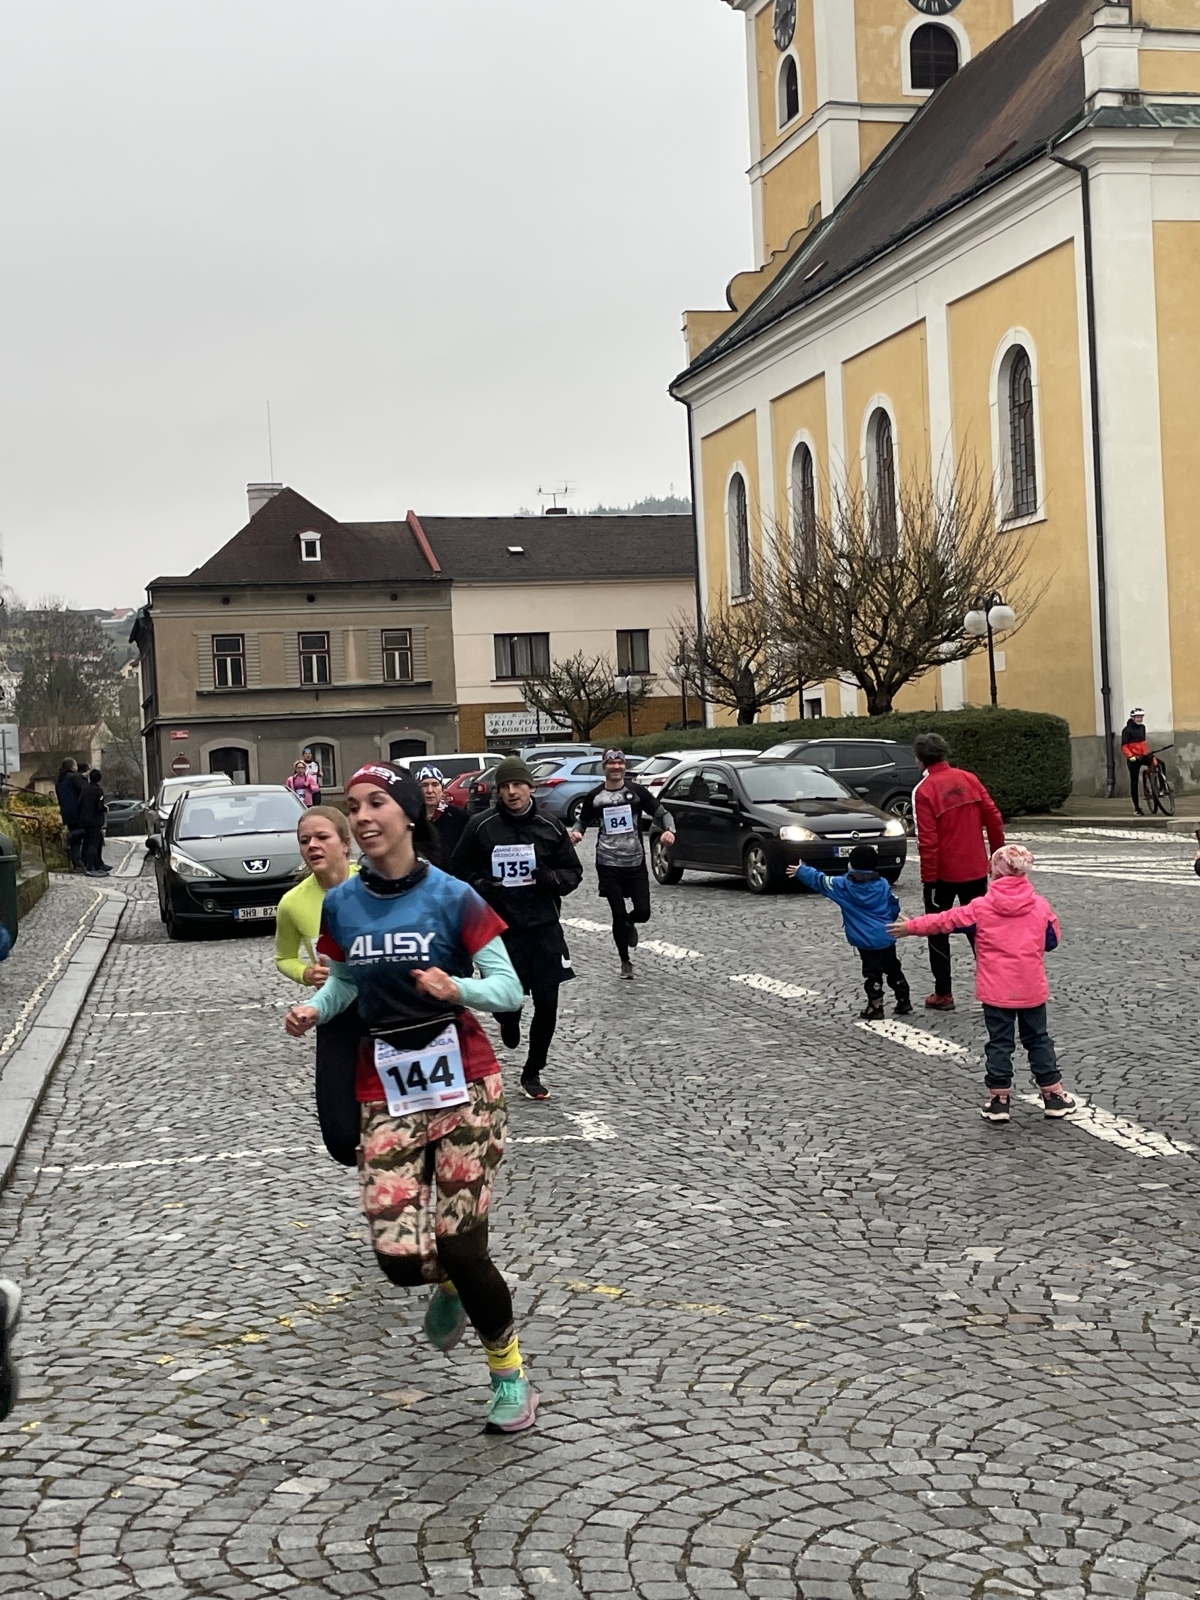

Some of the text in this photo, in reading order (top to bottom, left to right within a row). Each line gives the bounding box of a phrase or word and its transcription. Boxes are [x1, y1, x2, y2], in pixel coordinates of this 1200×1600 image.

[489, 719, 513, 727] SKLO
[610, 816, 628, 829] 84
[497, 861, 530, 878] 135
[240, 908, 257, 918] 3H9
[349, 931, 436, 958] ALISY
[383, 955, 419, 963] TEAM
[386, 1055, 455, 1096] 144
